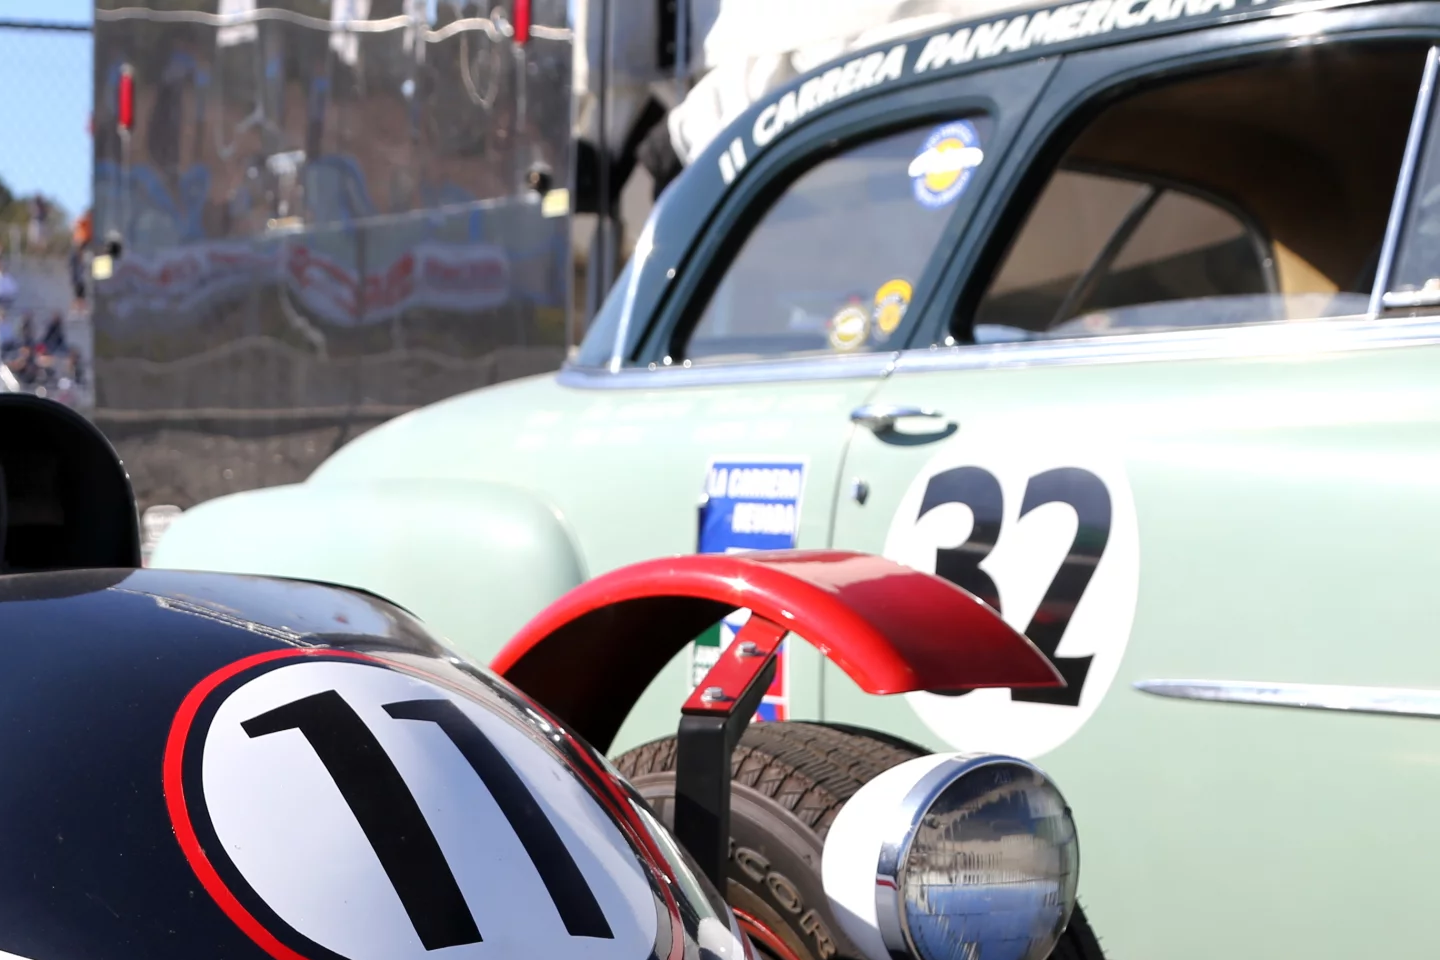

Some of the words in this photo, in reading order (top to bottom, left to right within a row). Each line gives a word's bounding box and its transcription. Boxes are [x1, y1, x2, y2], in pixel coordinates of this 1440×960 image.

[753, 45, 907, 147] CARRERA
[914, 0, 1236, 74] PANAMERICANA
[915, 465, 1112, 707] 32
[240, 689, 614, 951] 11
